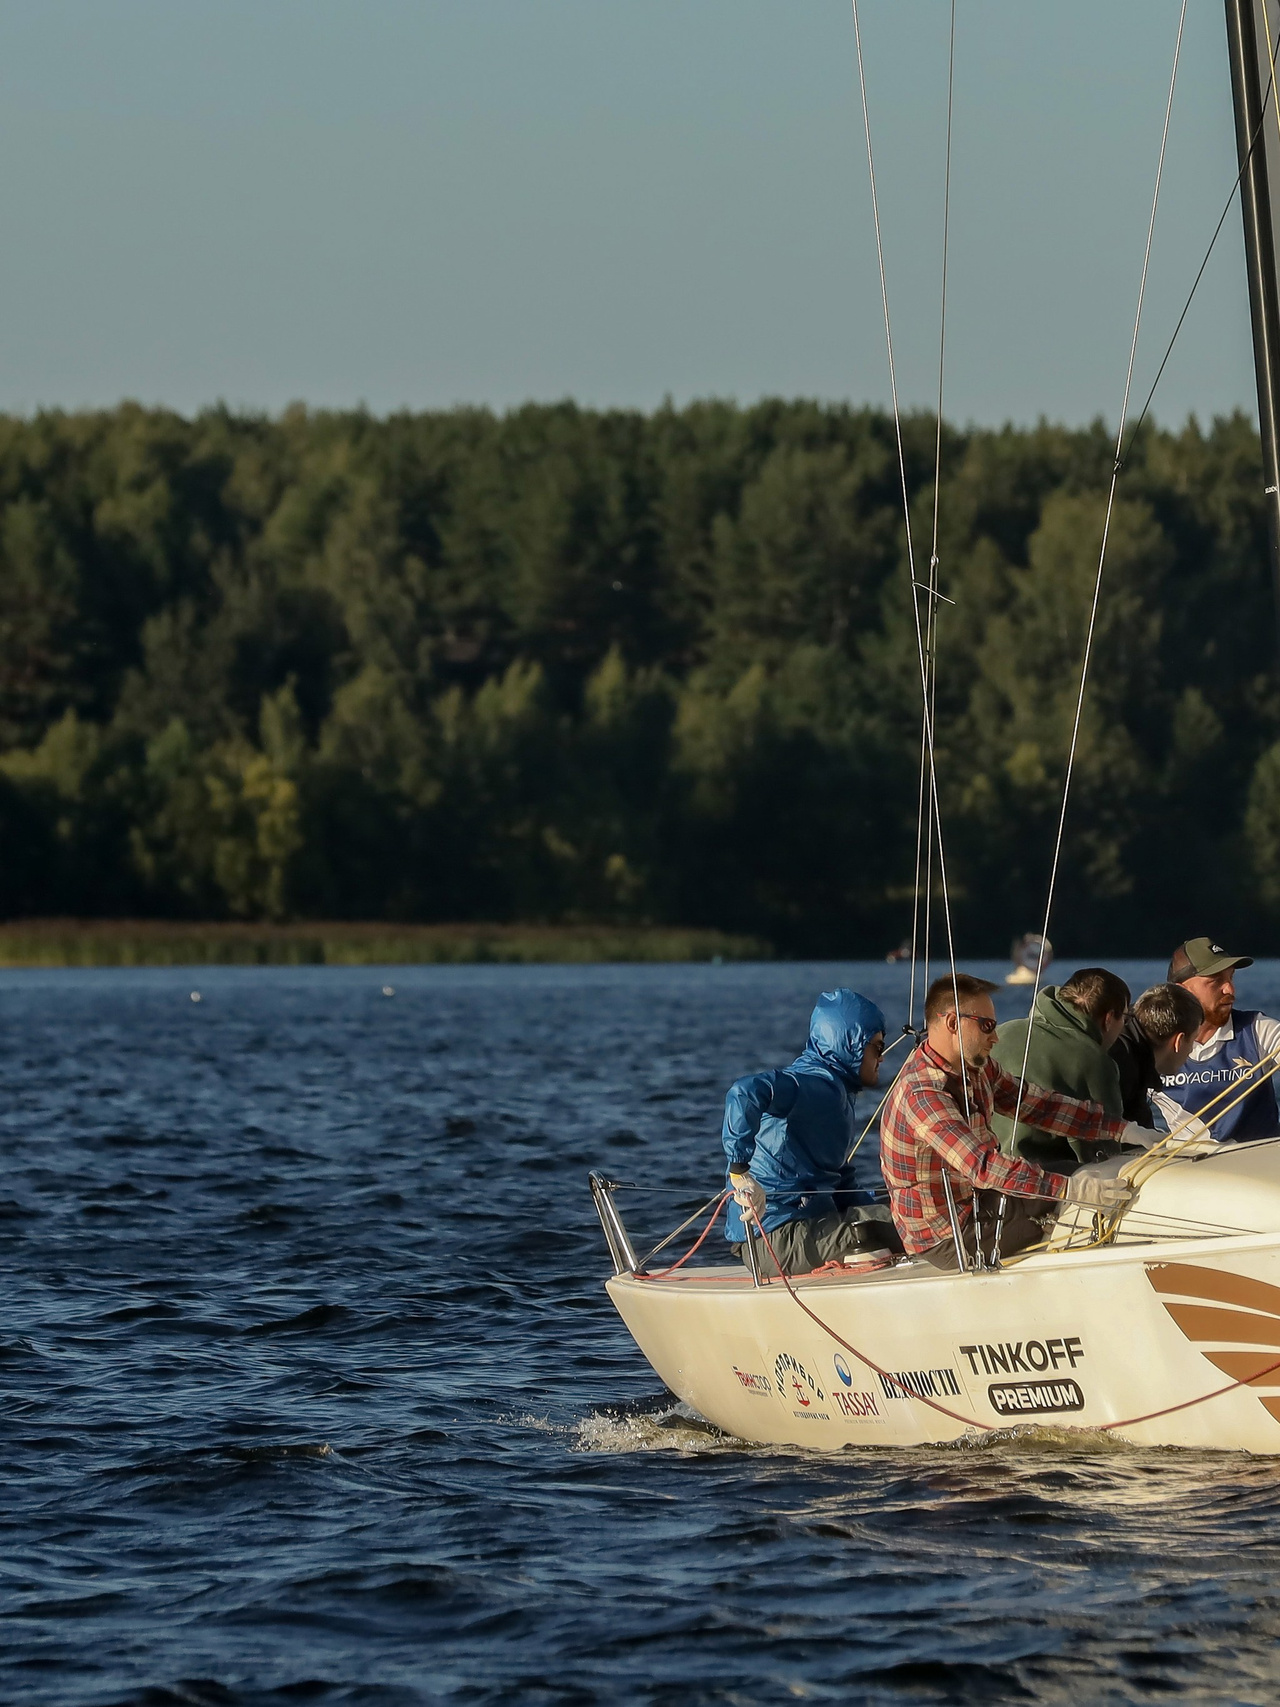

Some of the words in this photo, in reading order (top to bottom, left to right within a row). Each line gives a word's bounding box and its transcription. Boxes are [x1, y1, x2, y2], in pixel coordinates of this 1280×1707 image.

[959, 1336, 1085, 1375] TINKOFF
[877, 1368, 962, 1401] ВЕДОМОСТИ
[992, 1384, 1080, 1410] PREMIUM
[832, 1391, 880, 1416] TASSAY
